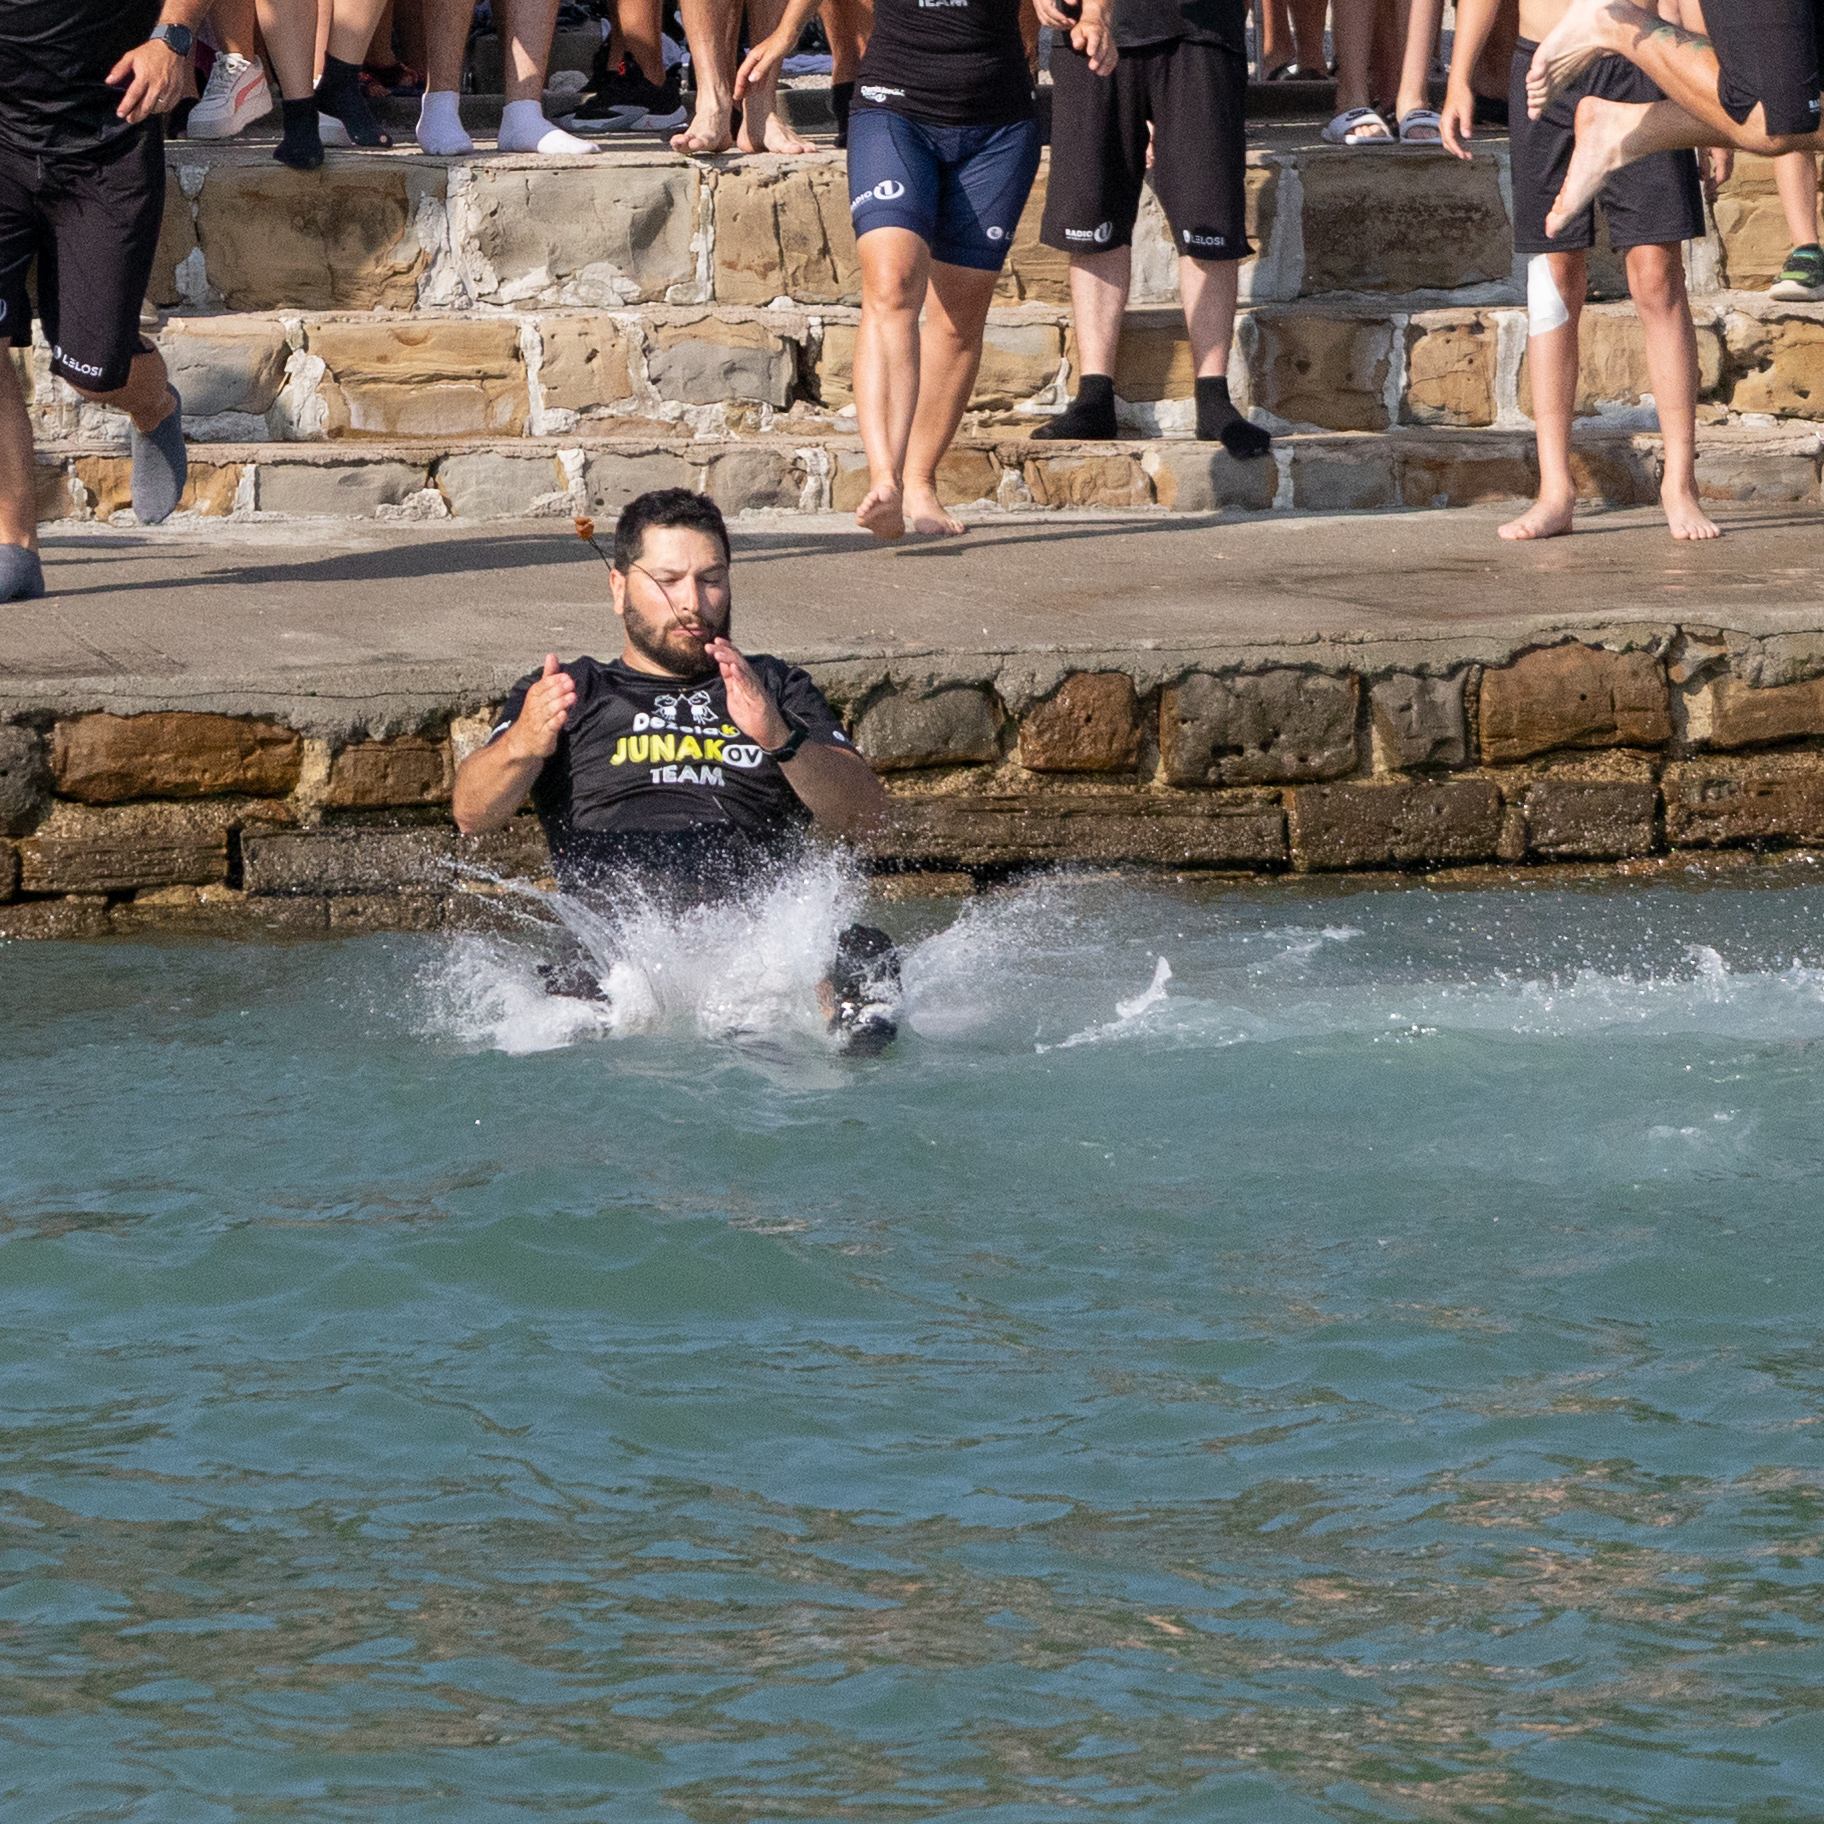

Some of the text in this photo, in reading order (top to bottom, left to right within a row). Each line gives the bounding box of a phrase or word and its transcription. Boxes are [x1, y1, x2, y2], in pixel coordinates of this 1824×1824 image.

[1065, 228, 1094, 237] RADIO
[62, 354, 103, 377] LELOSI
[650, 765, 726, 787] TEAM
